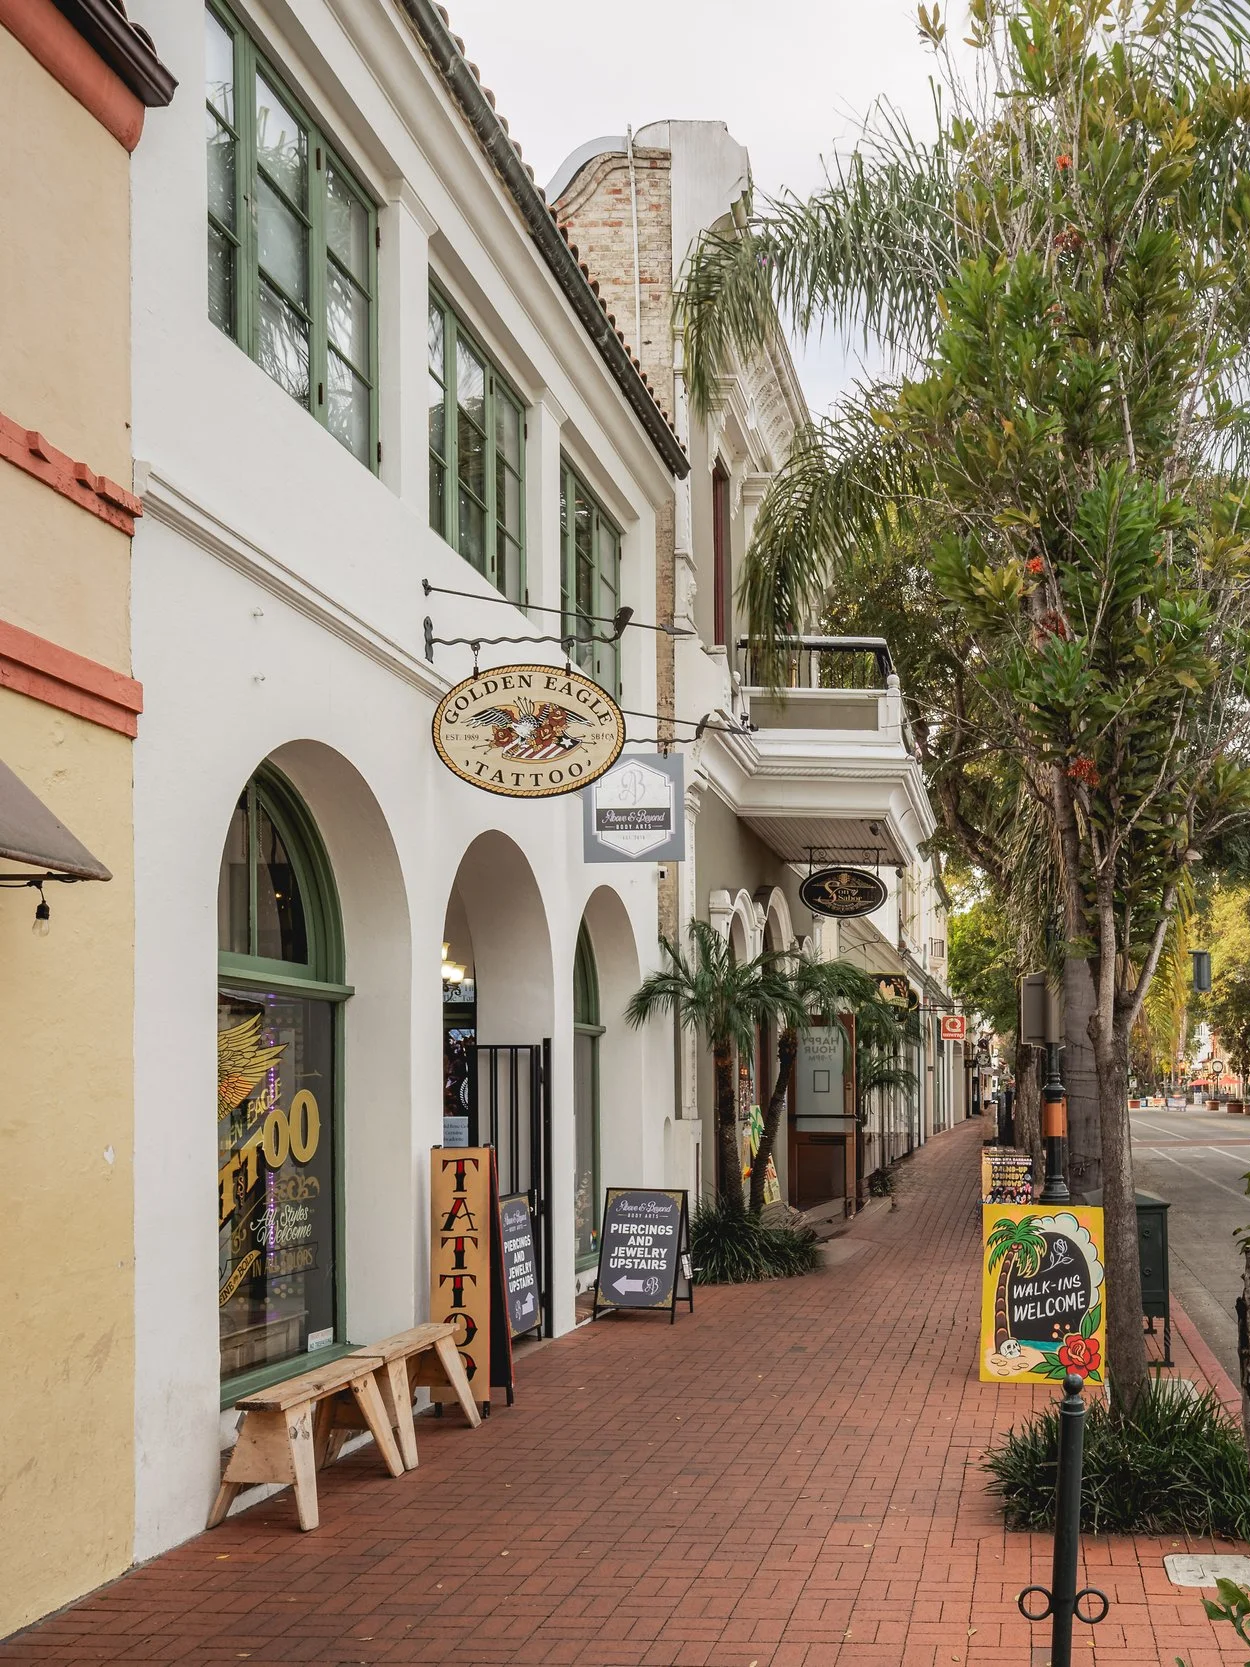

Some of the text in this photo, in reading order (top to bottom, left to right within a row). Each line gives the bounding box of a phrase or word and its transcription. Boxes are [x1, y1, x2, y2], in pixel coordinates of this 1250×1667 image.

[444, 674, 613, 726] GOLDEN EAGLE
[474, 760, 584, 787] TATTOO
[602, 808, 666, 824] Above & Beyond
[616, 1199, 673, 1214] Above & Beyond
[250, 1204, 309, 1231] All Styles
[256, 1222, 312, 1246] Welcome
[610, 1223, 674, 1236] PIERCINGS
[503, 1234, 531, 1254] PIERCINGS
[627, 1235, 653, 1247] AND
[513, 1250, 525, 1264] AND
[611, 1246, 668, 1259] JEWELRY
[237, 1253, 254, 1277] BOLD
[252, 1259, 262, 1278] IN
[508, 1260, 533, 1280] JEWELRY
[609, 1257, 667, 1270] UPSTAIRS
[508, 1273, 534, 1293] UPSTAIRS
[1013, 1274, 1082, 1299] WALK-INS
[1013, 1290, 1086, 1323] WELCOME
